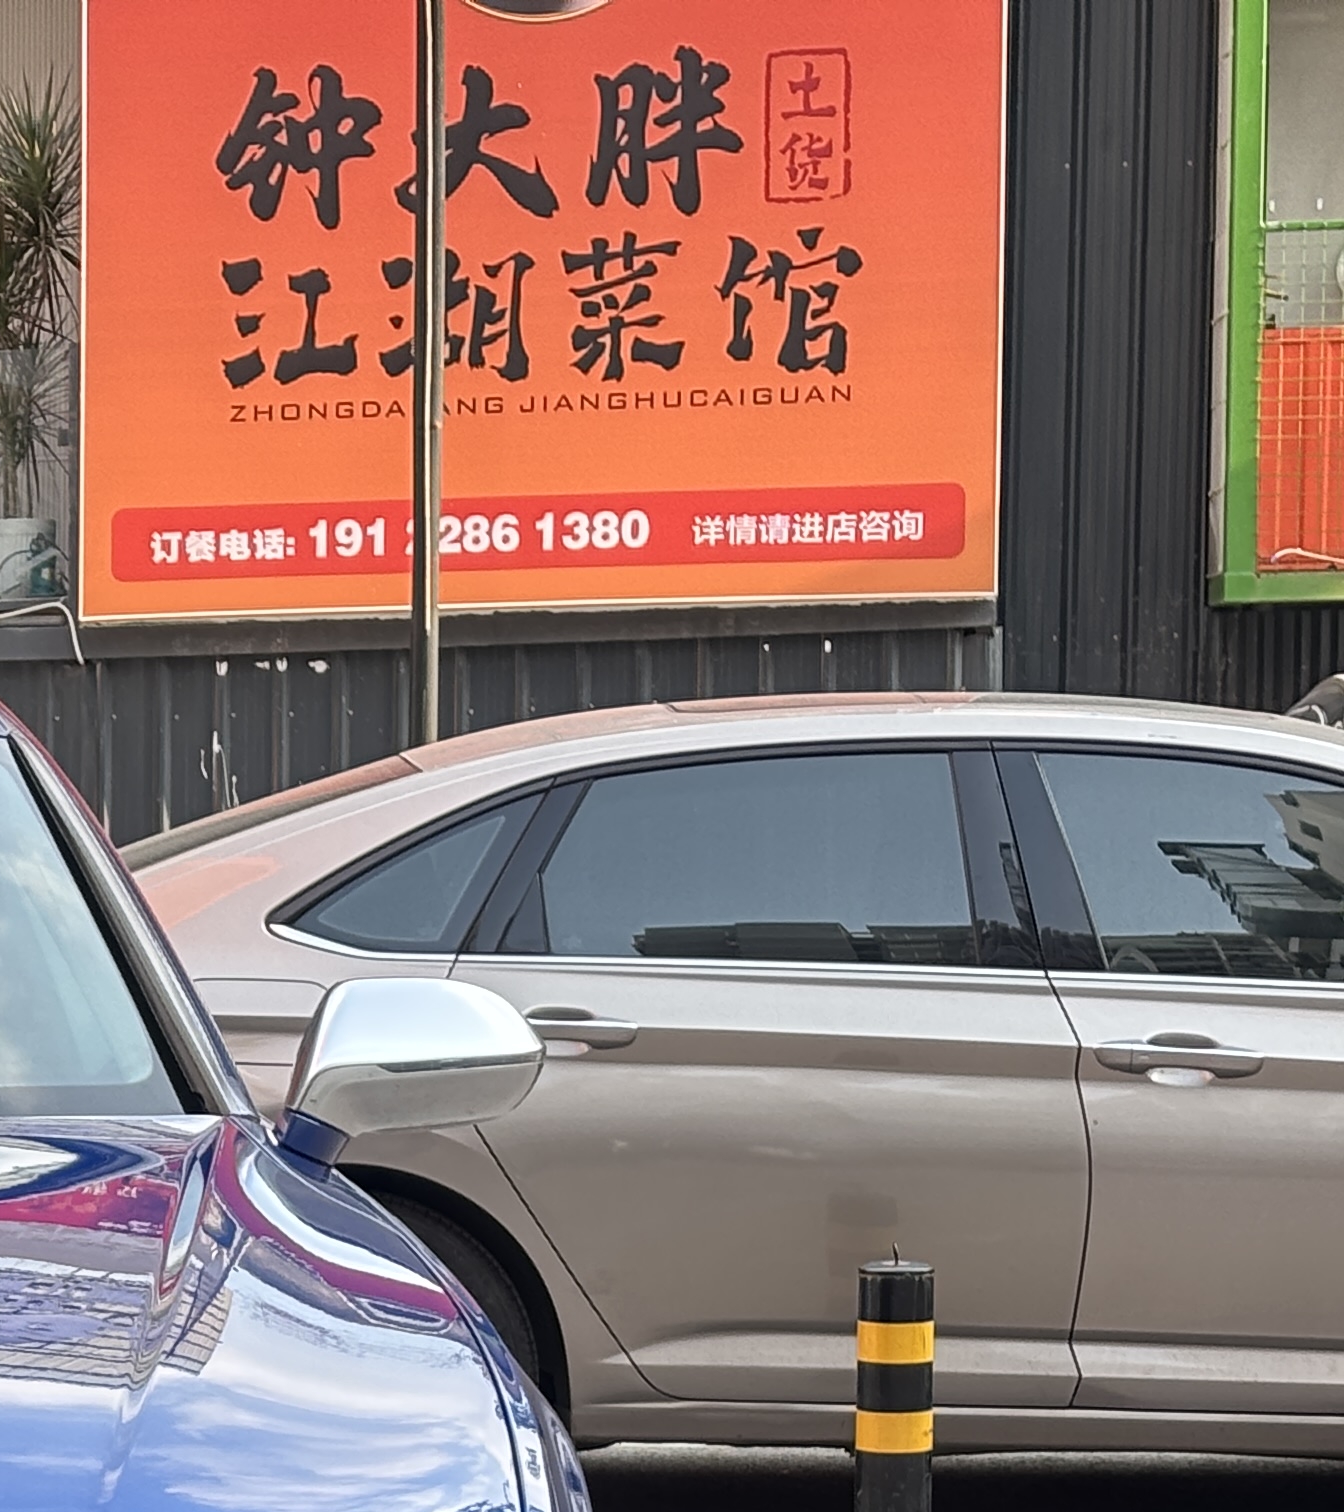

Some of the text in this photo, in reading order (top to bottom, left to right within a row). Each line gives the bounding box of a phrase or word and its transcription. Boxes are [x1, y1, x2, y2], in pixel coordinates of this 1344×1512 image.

[216, 45, 745, 230] 钟大胖
[775, 58, 842, 194] 土货
[221, 226, 864, 389] 江湖菜馆
[229, 384, 853, 424] ZHONGDANG JIANGHUCAIGUAN
[150, 508, 926, 565] 订餐电话: 191 286 1380 详情请进店咨询
